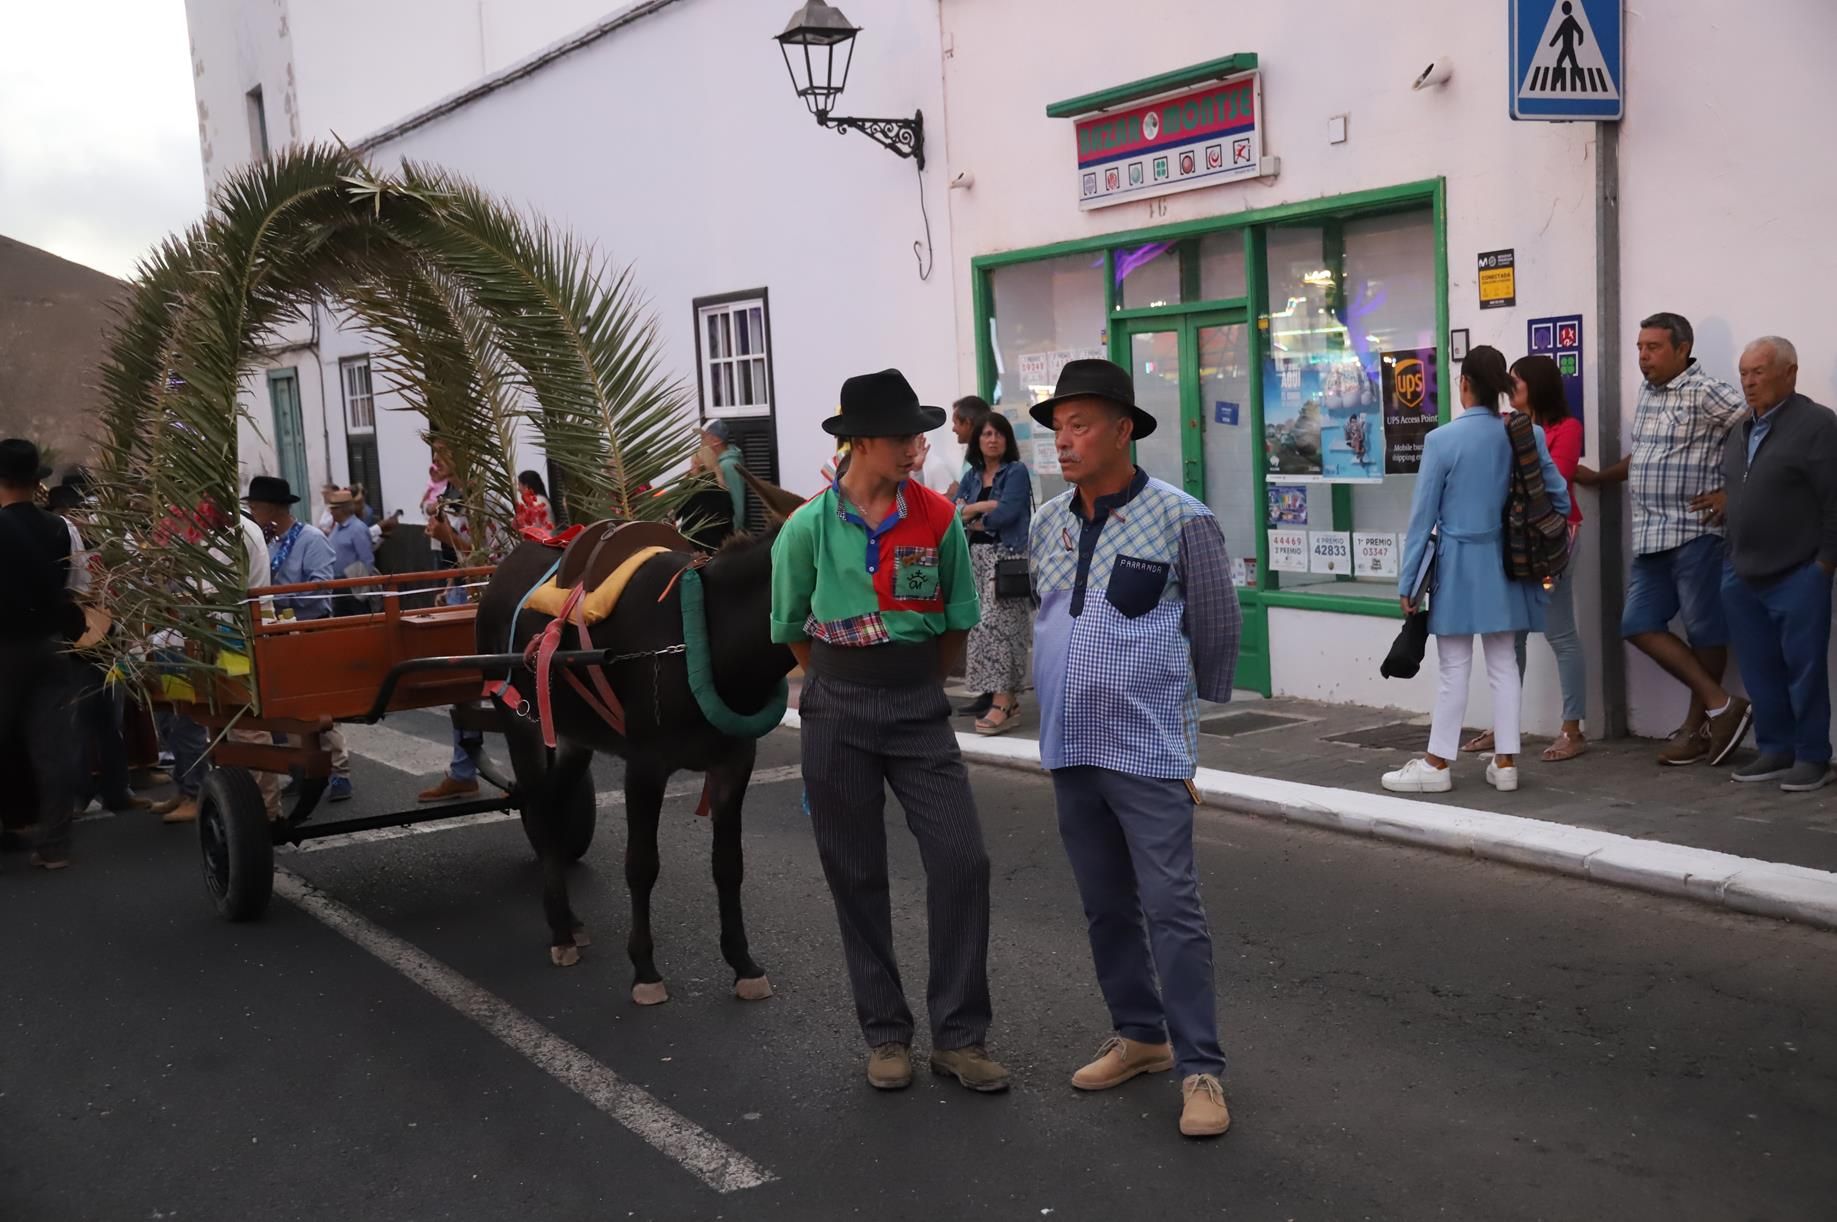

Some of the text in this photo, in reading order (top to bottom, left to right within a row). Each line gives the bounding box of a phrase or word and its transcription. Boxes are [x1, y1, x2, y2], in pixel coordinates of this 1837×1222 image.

[1078, 87, 1251, 155] BAZAR MONTSE
[1397, 374, 1423, 400] ups
[1386, 413, 1438, 425] UPS Access Point
[1393, 443, 1412, 452] Mobile
[1273, 536, 1302, 546] 44469
[1321, 537, 1344, 545] PREMIO
[1365, 537, 1392, 546] PREMIO
[1280, 546, 1302, 555] PREMIO
[1314, 544, 1347, 557] 42833
[1362, 547, 1388, 557] 03347
[1119, 559, 1162, 574] PARRANDA
